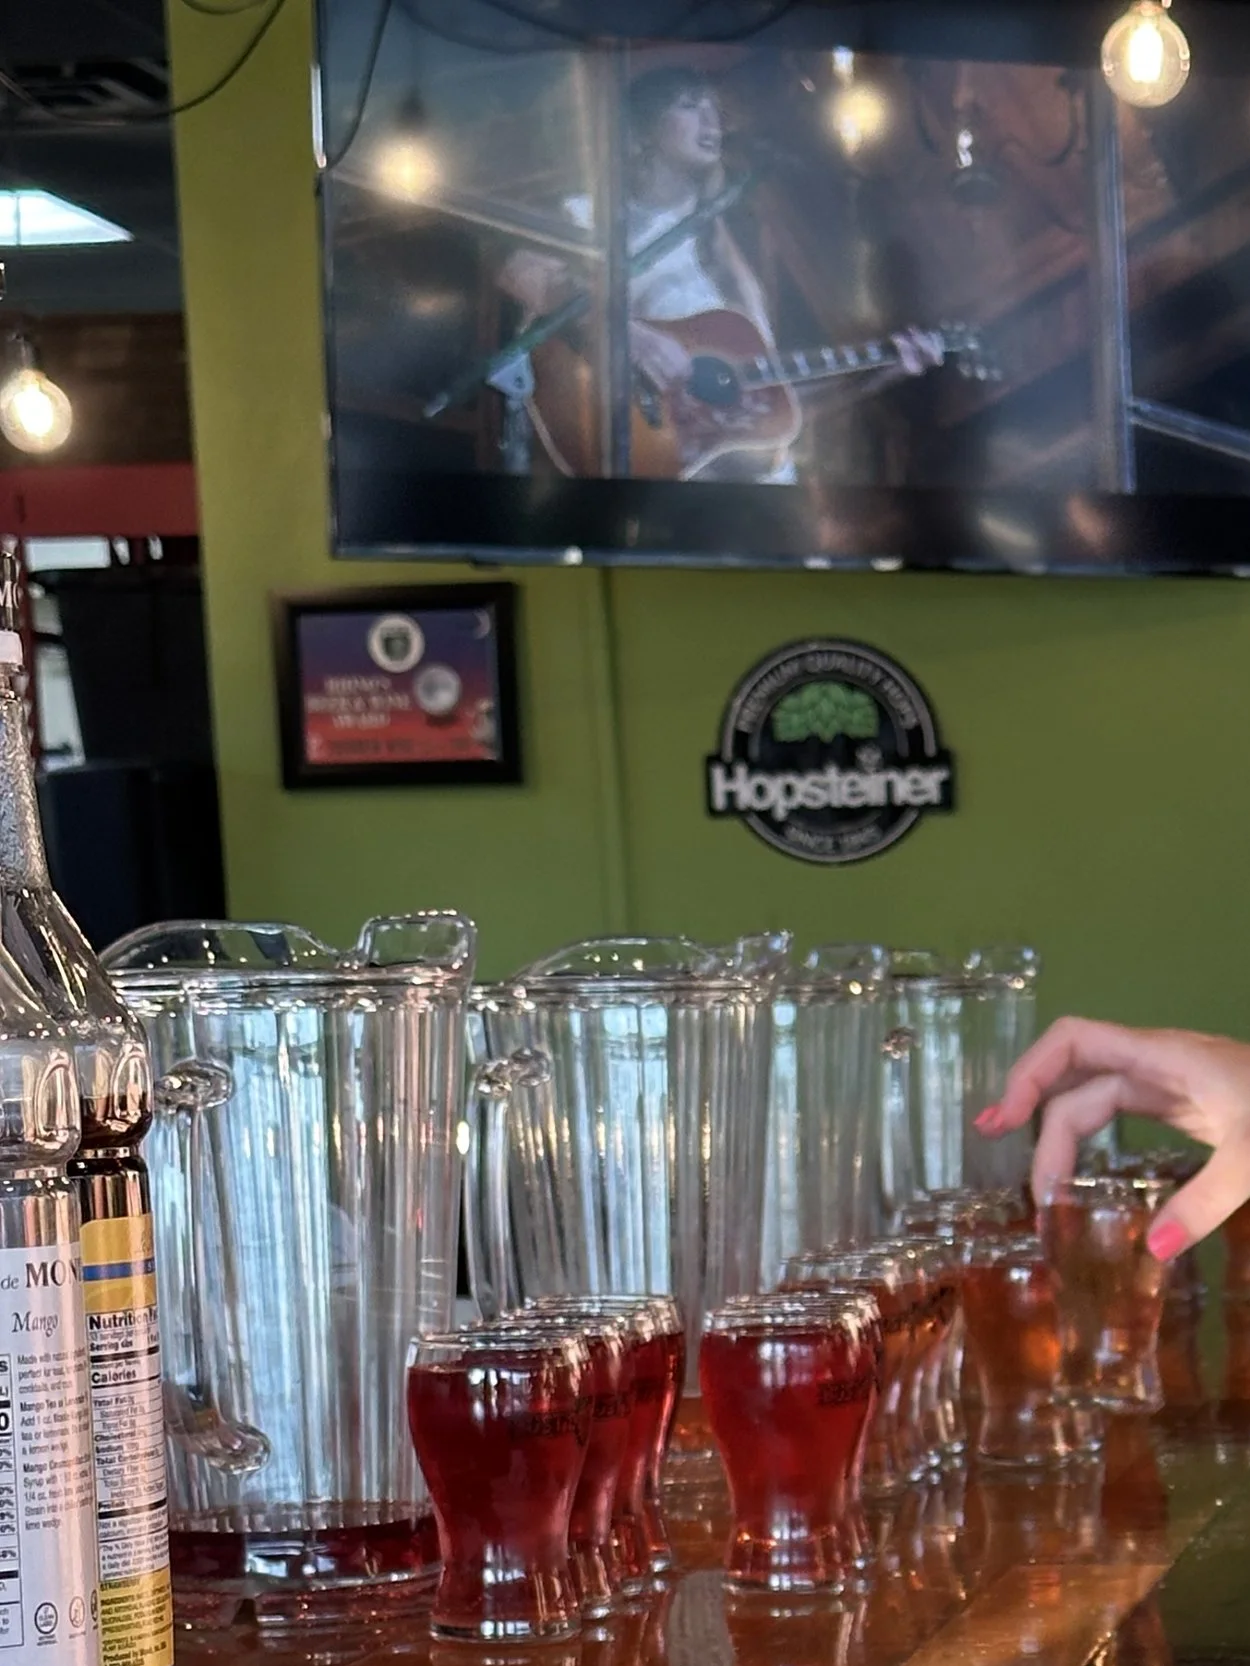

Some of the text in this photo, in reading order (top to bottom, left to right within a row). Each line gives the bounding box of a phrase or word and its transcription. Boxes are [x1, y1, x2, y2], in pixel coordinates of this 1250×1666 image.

[709, 746, 950, 822] Hopsteiner
[0, 1274, 19, 1290] de
[11, 1311, 59, 1338] Mango
[89, 1311, 148, 1330] Nutrition
[91, 1369, 136, 1384] Calories
